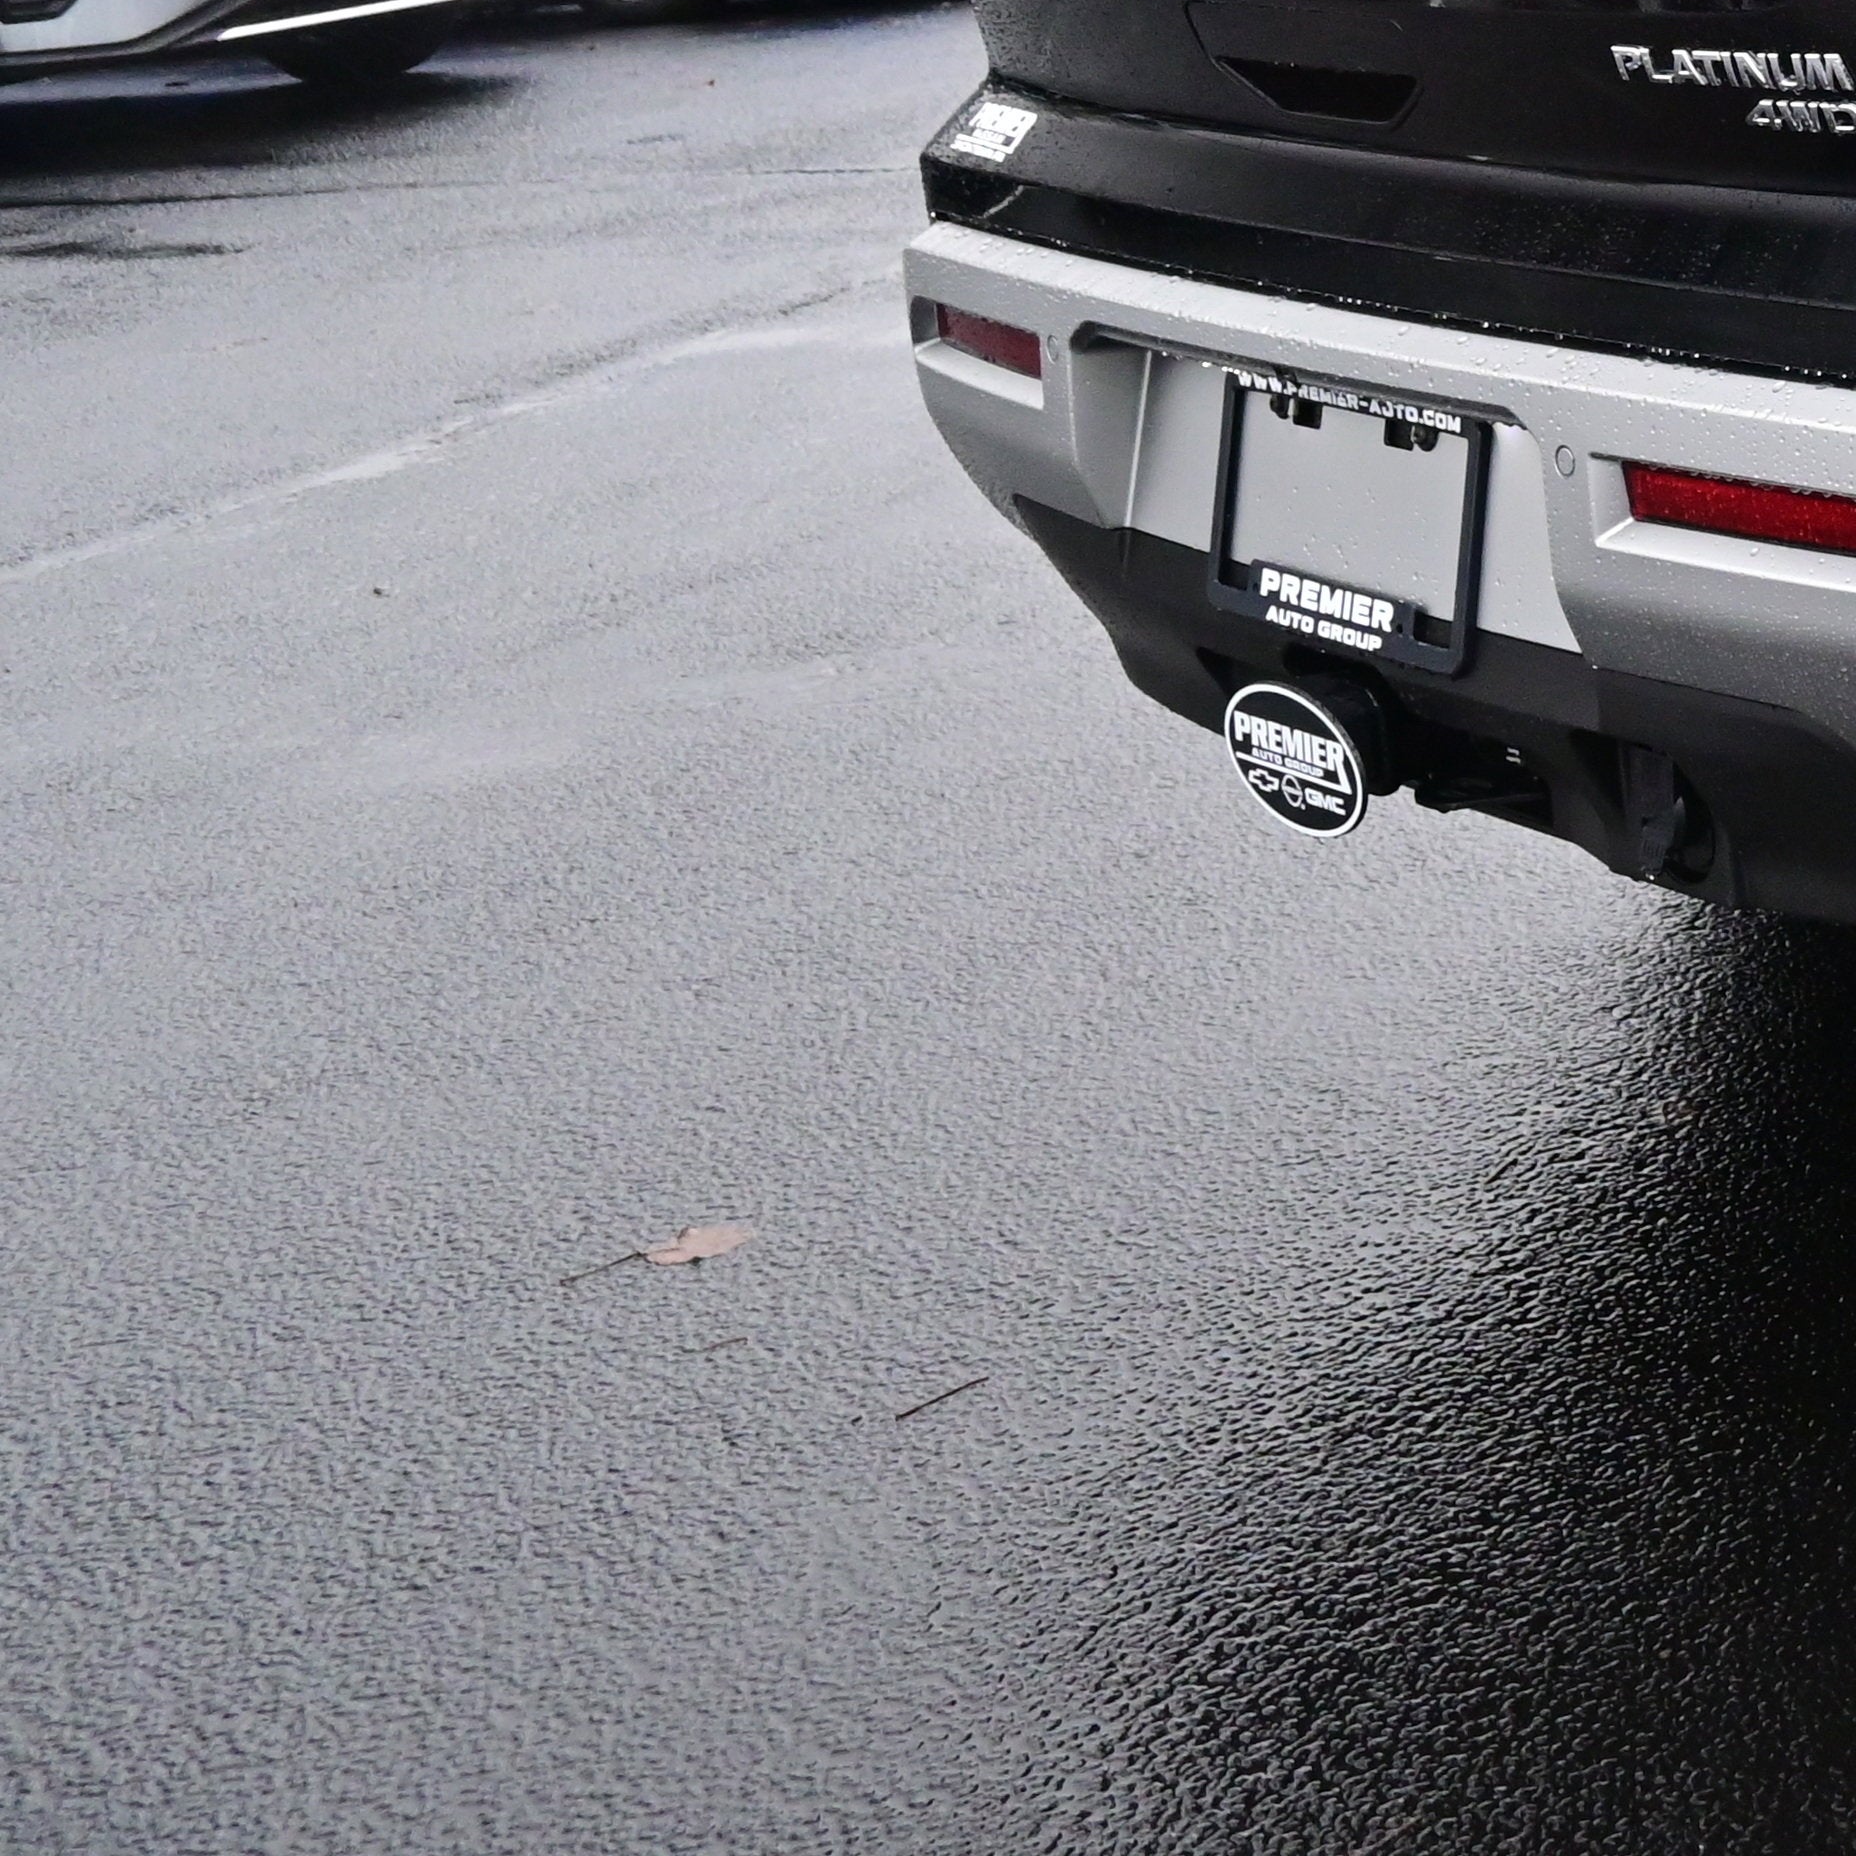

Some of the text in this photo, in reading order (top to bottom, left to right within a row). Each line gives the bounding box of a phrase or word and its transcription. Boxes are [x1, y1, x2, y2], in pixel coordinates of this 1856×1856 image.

[1611, 45, 1855, 93] PLATINUM
[1260, 567, 1394, 633] PREMIER
[1265, 605, 1382, 651] AUTO GROUP
[1234, 710, 1344, 772] PREMIER
[1252, 747, 1324, 777] AUTO GROUP
[1304, 787, 1346, 816] GMC
